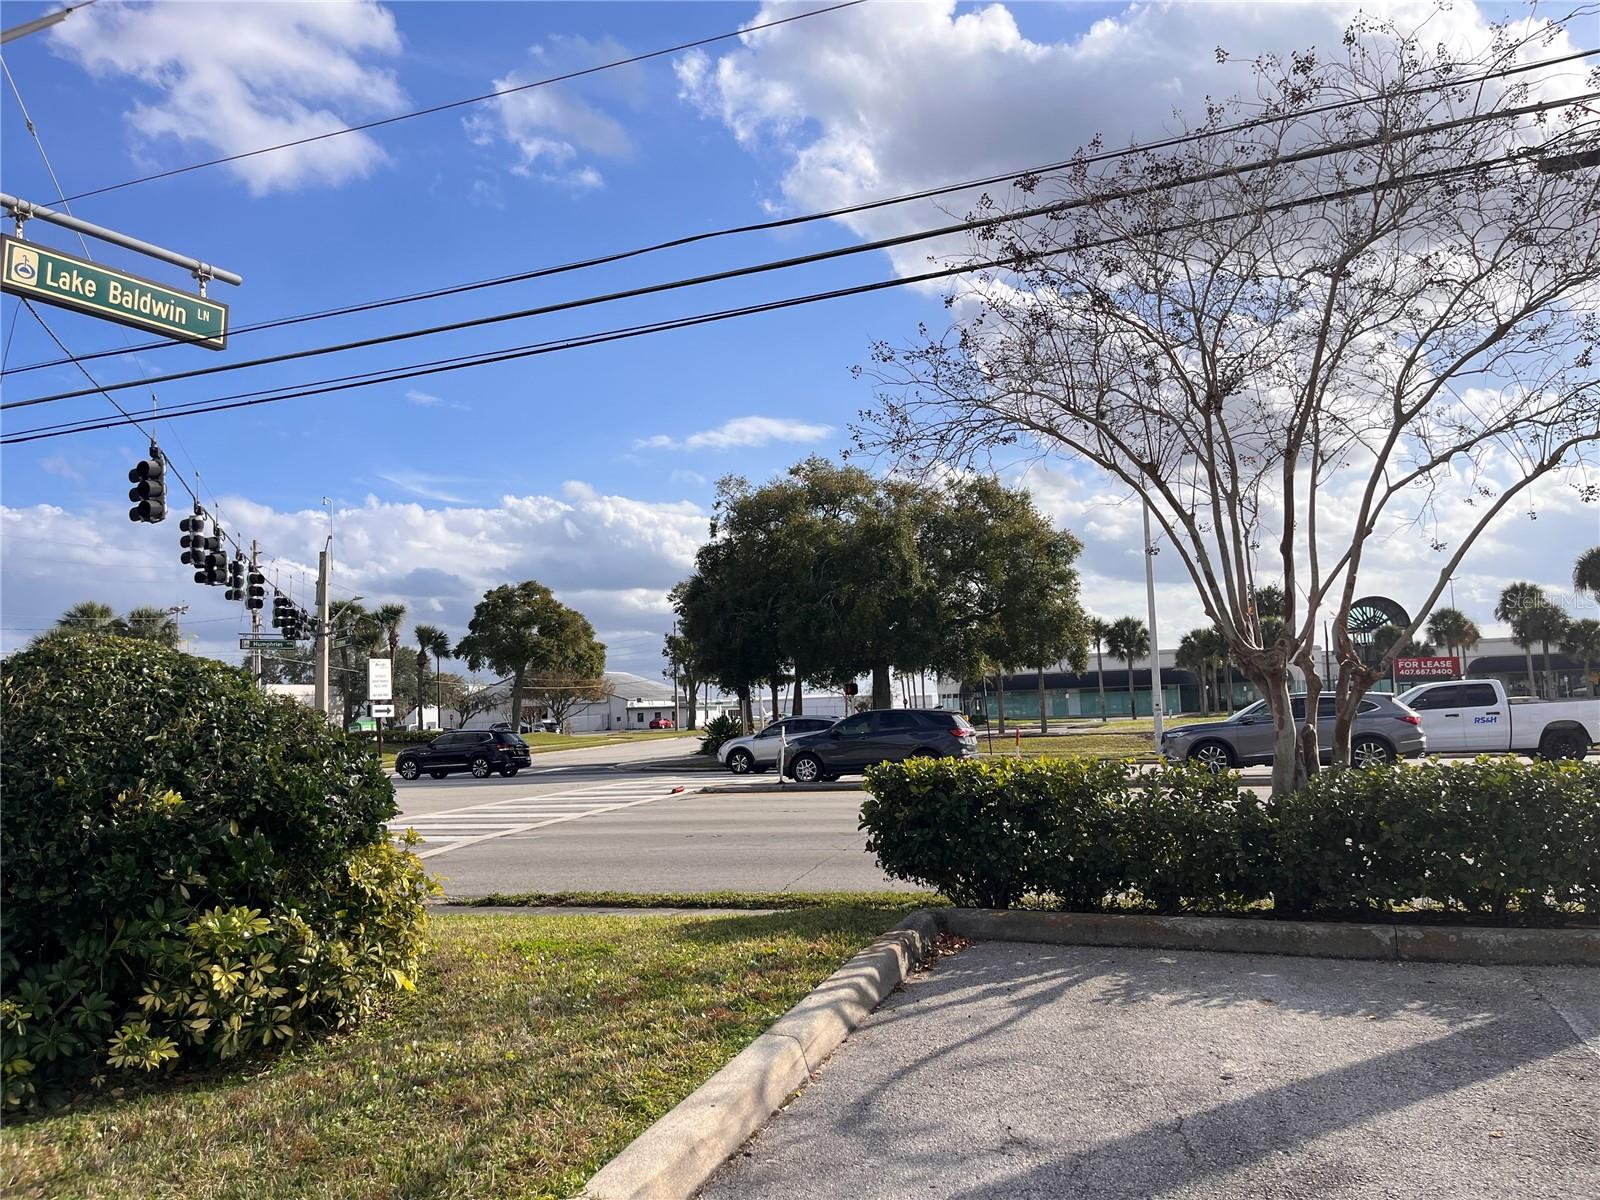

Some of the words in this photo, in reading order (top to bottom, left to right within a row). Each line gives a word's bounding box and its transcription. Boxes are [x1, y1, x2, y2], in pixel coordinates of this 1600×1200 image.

[46, 261, 97, 298] Lake
[108, 280, 187, 325] Baldwin
[197, 308, 210, 322] LN
[1421, 660, 1453, 668] LEASE
[1399, 668, 1453, 676] 407.667.9400
[1474, 716, 1497, 724] RS&H
